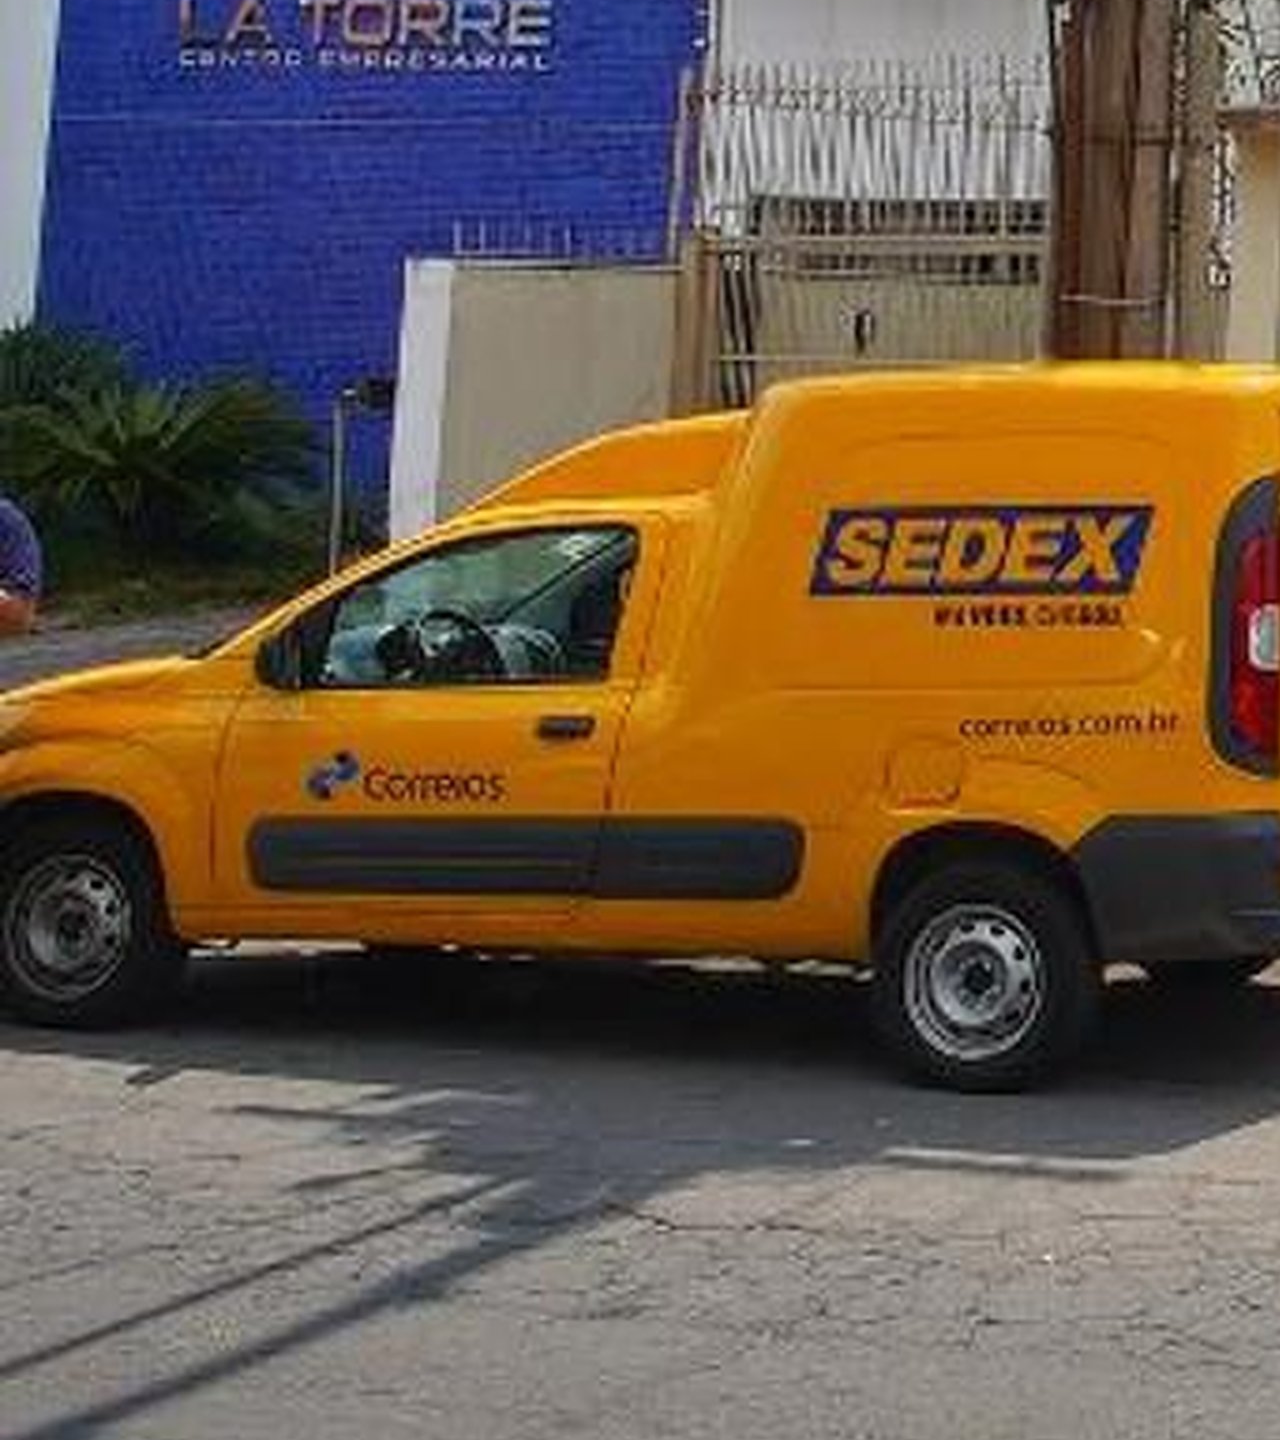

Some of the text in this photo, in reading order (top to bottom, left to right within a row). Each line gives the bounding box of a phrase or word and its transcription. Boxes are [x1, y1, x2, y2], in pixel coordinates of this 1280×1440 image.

[827, 514, 1134, 586] SEDEX
[958, 709, 1179, 736] correios.com.br
[363, 766, 508, 802] Correios
